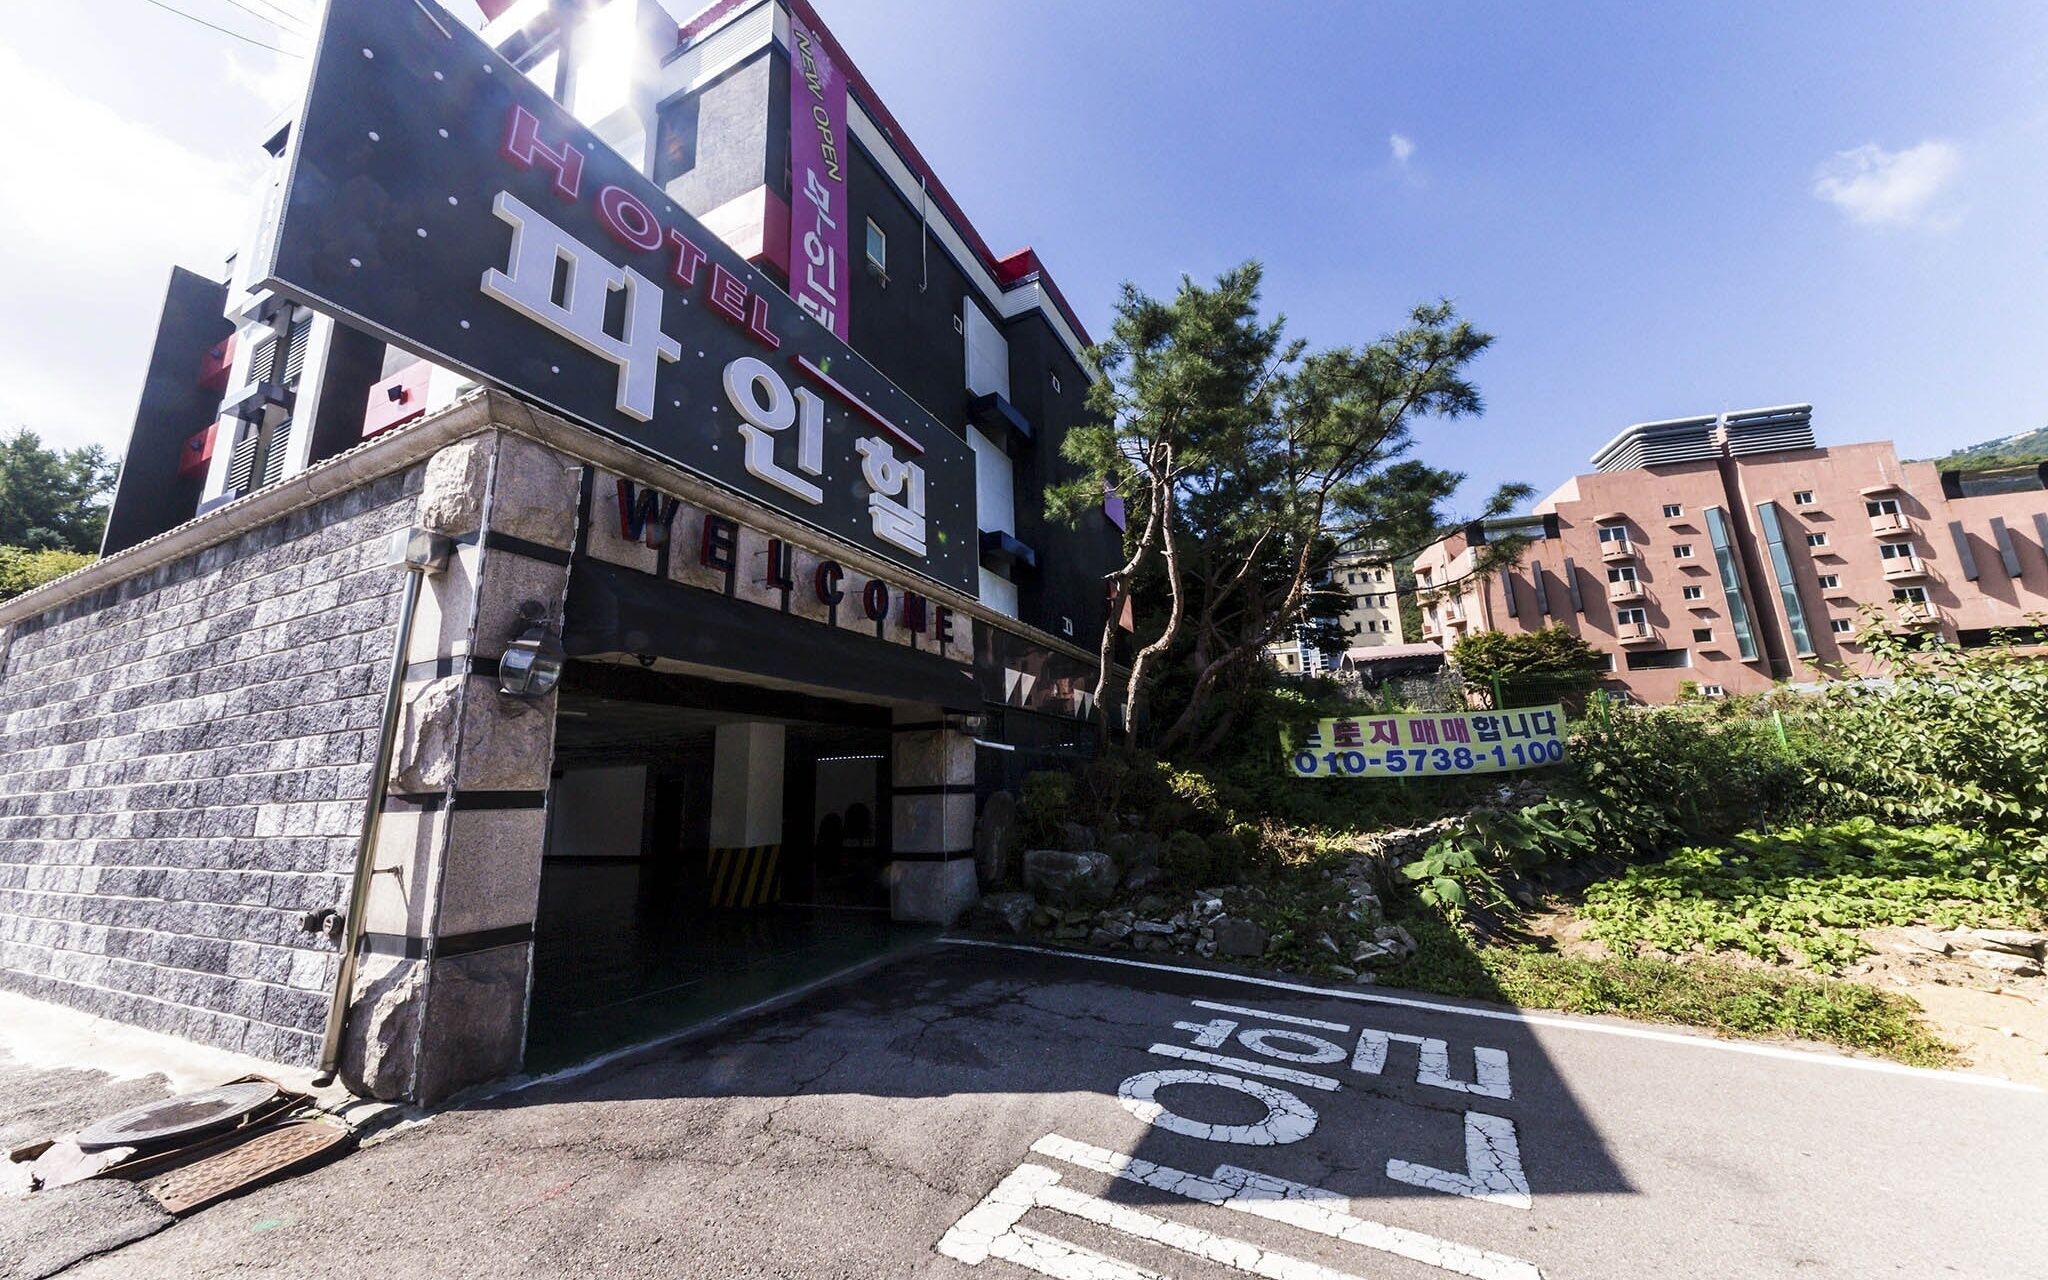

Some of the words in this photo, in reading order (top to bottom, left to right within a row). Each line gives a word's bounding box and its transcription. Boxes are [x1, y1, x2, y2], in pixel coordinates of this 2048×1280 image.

[794, 29, 824, 101] NEW
[812, 104, 843, 182] OPEN
[502, 103, 780, 351] HOTEL
[480, 190, 927, 557] 파인힐
[616, 478, 954, 643] WELCOME
[1295, 739, 1564, 774] 010-5738-1100
